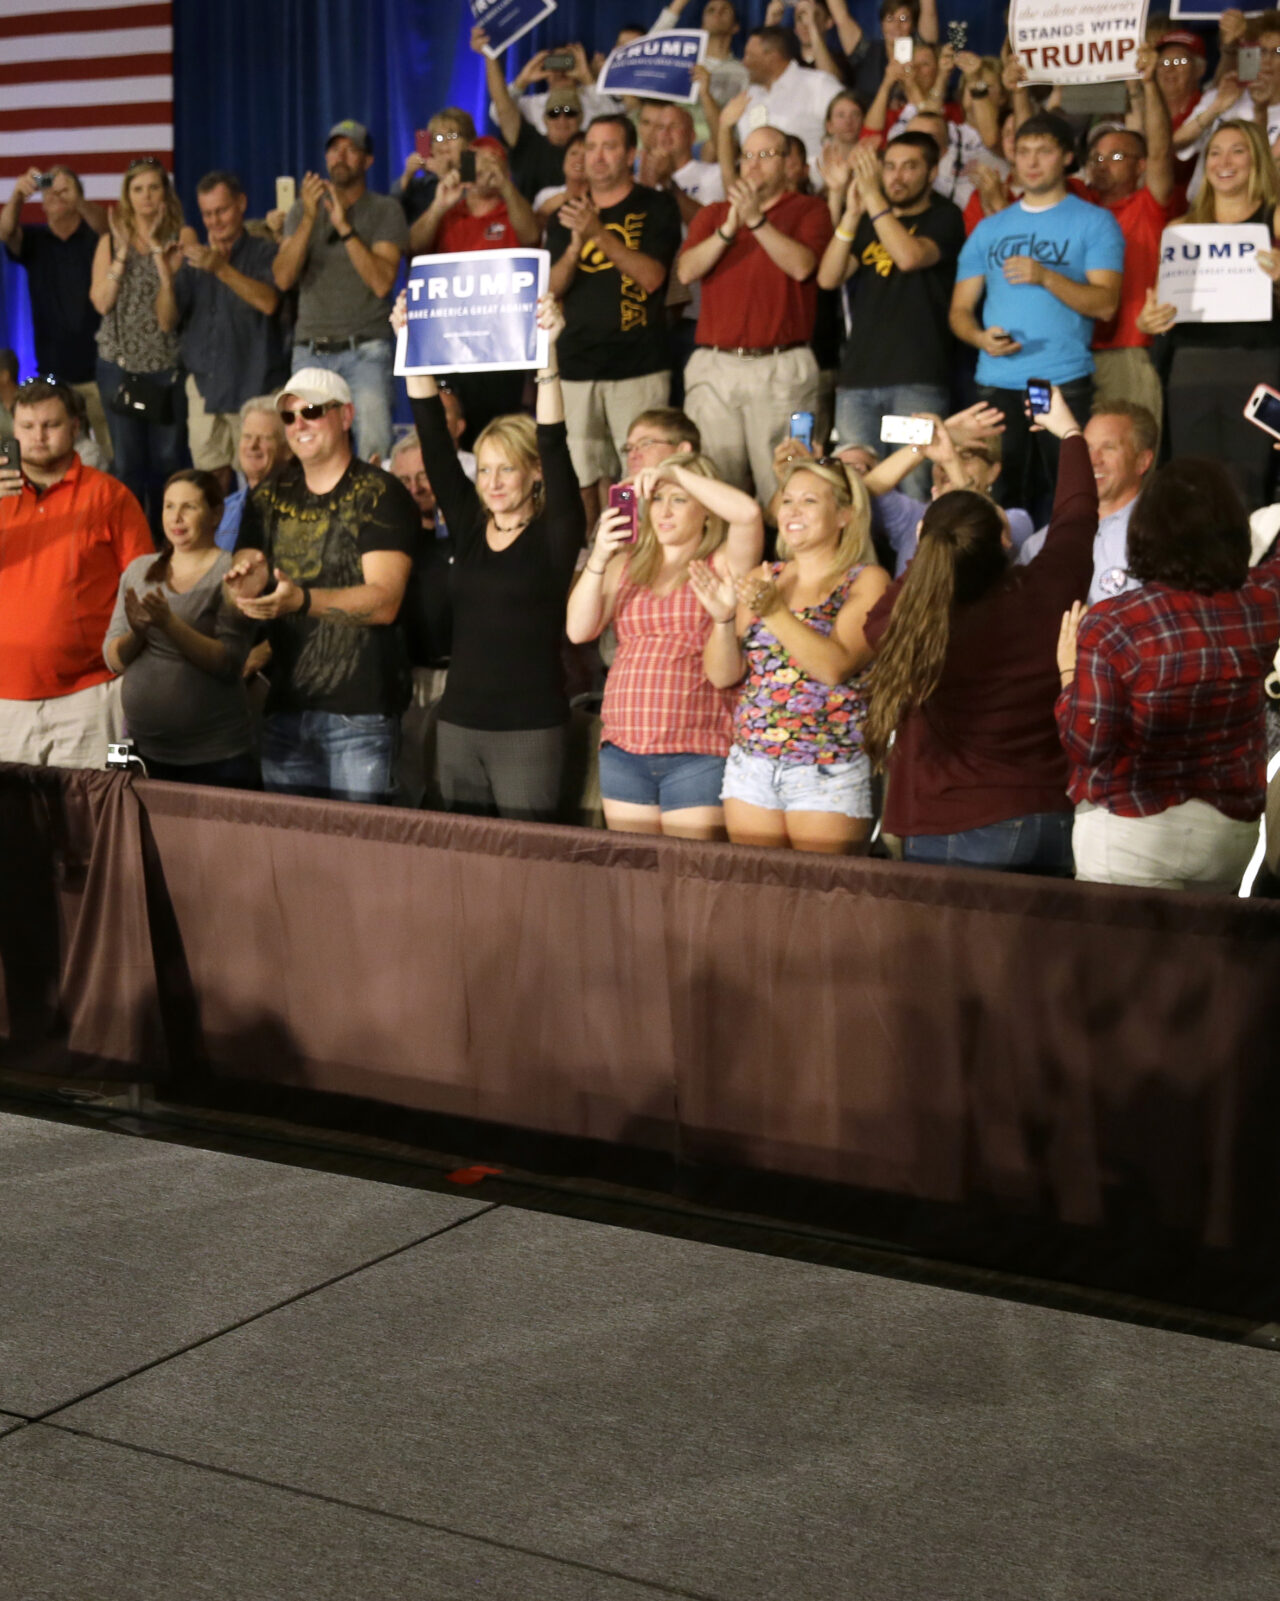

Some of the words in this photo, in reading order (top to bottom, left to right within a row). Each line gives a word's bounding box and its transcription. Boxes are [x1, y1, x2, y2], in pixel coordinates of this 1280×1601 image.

[1018, 22, 1085, 42] STANDS
[1091, 18, 1137, 33] WITH
[1019, 38, 1135, 69] TRUMP
[1161, 243, 1256, 263] RUMP
[408, 271, 535, 302] TRUMP
[430, 306, 469, 318] AMERICA
